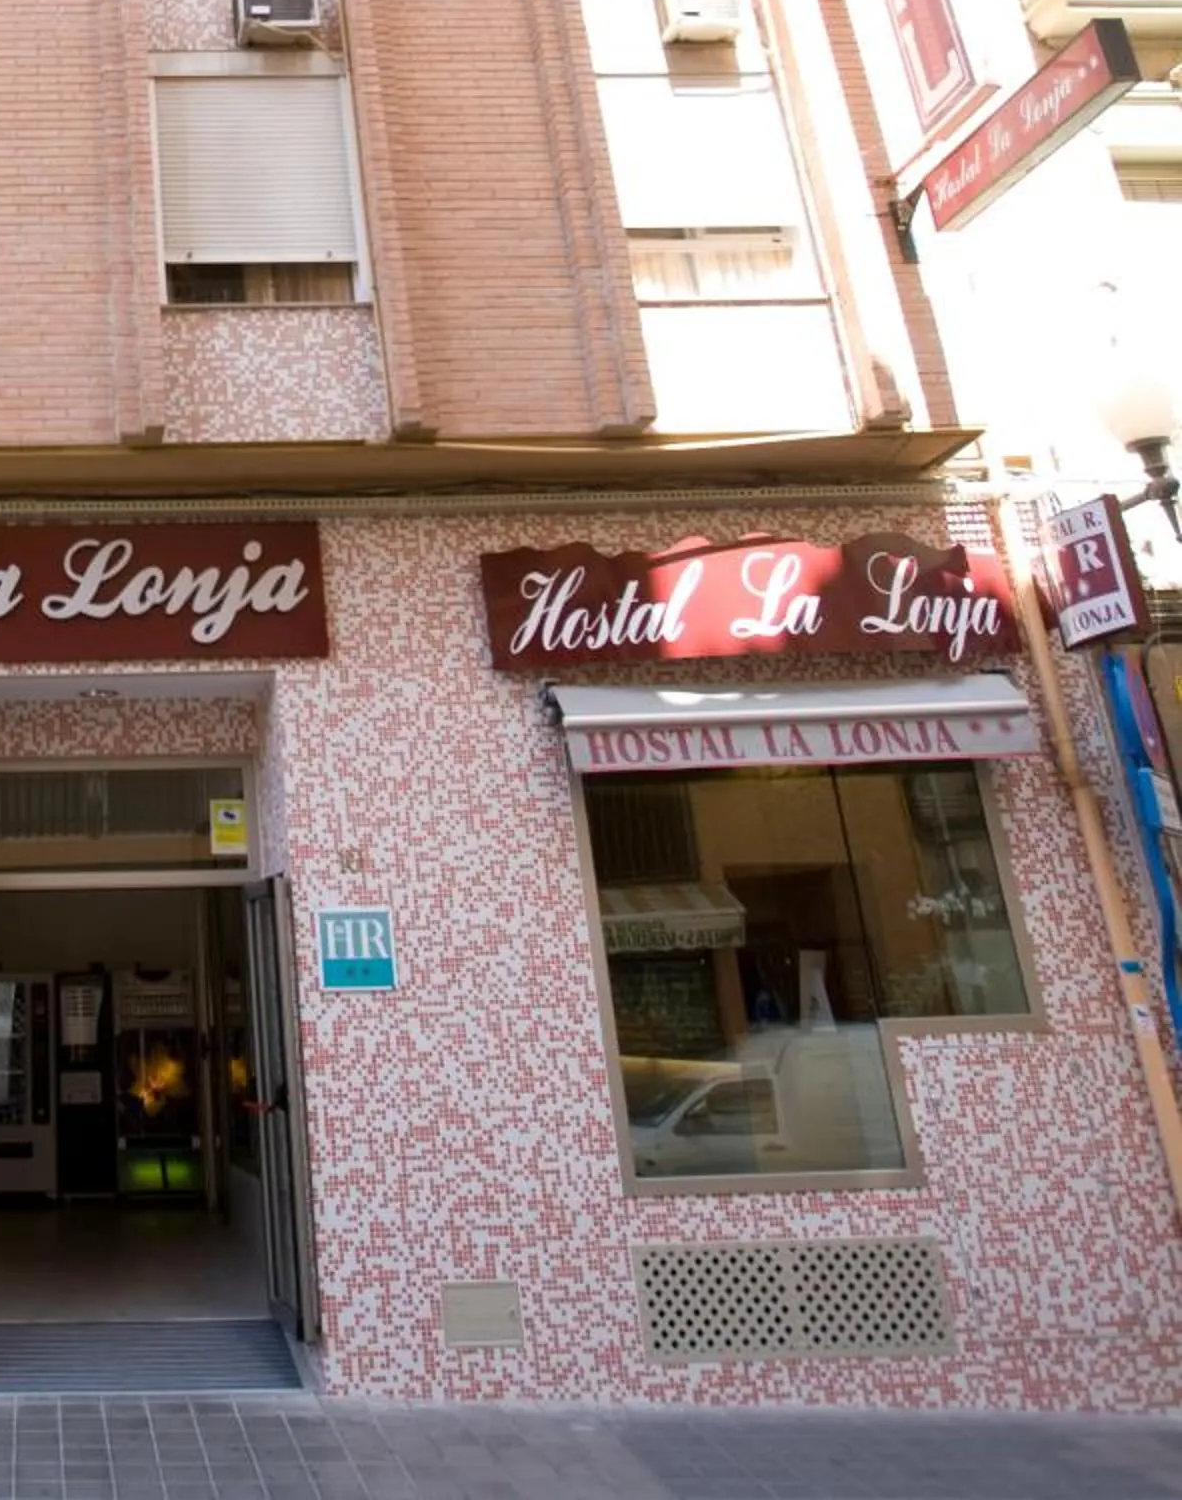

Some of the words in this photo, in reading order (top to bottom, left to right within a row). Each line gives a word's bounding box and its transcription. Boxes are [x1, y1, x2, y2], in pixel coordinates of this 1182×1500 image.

[41, 538, 309, 644] Lonja
[510, 558, 704, 656] Hostal
[728, 551, 824, 639] La
[860, 550, 1001, 662] Lonja
[587, 725, 745, 766] HOSTAL
[761, 724, 815, 758] LA
[833, 719, 961, 757] LONJA
